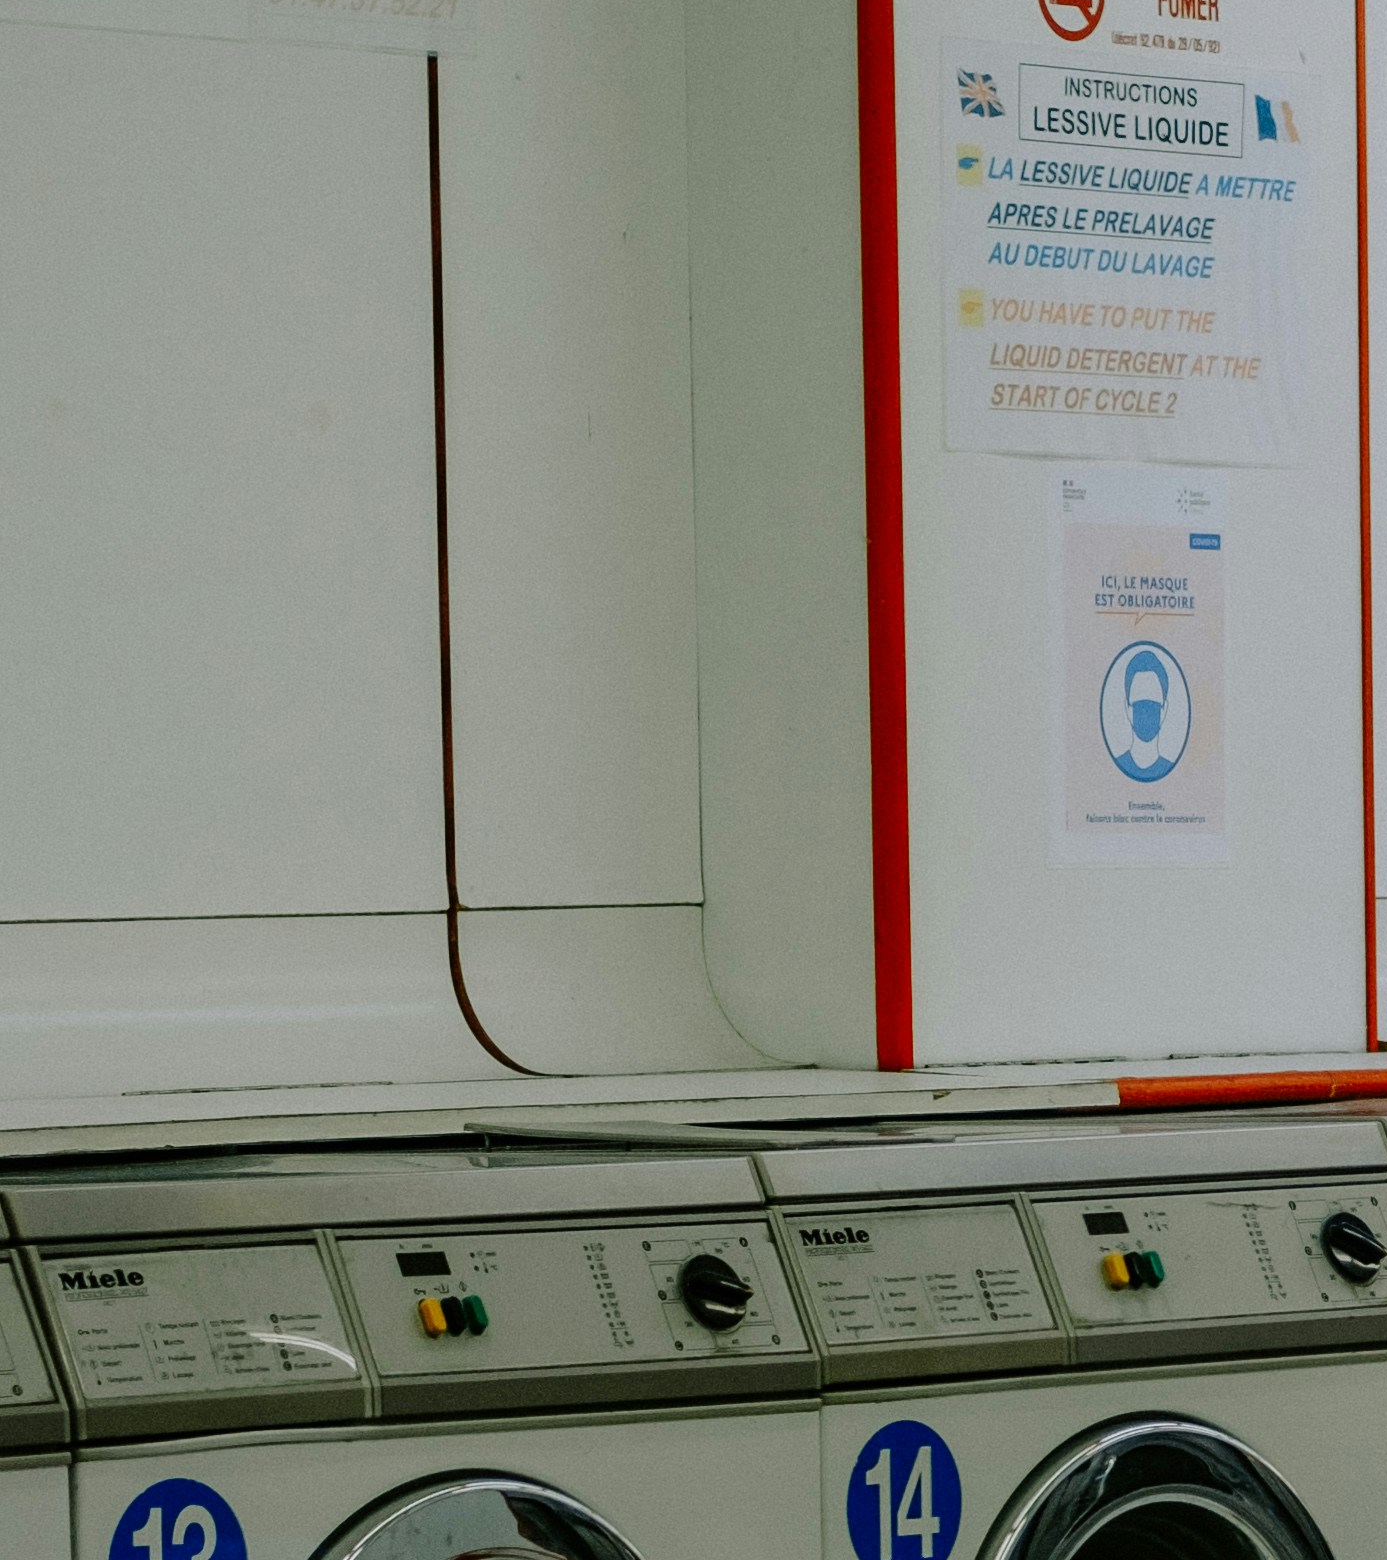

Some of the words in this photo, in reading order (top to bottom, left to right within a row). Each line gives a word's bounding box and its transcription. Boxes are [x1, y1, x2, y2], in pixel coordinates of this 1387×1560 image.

[1064, 77, 1198, 108] INSTRUCTIONS
[1033, 106, 1126, 139] LESSIVE
[1135, 116, 1230, 147] LIQUIDE
[988, 156, 1015, 181] LA
[1019, 160, 1104, 188] LESSIVE
[1108, 167, 1193, 196] LIQUIDE
[1195, 175, 1211, 196] A
[1214, 176, 1297, 203] METTRE
[988, 201, 1058, 228] APRES
[1063, 209, 1088, 231] LE
[1091, 210, 1215, 241] PRELAVAGE
[988, 242, 1020, 266] AU
[1024, 245, 1094, 271] DEBUT
[1097, 251, 1127, 273] DU
[1131, 253, 1215, 279] LAVAGE
[799, 1227, 870, 1246] Miele
[58, 1268, 144, 1290] Miele
